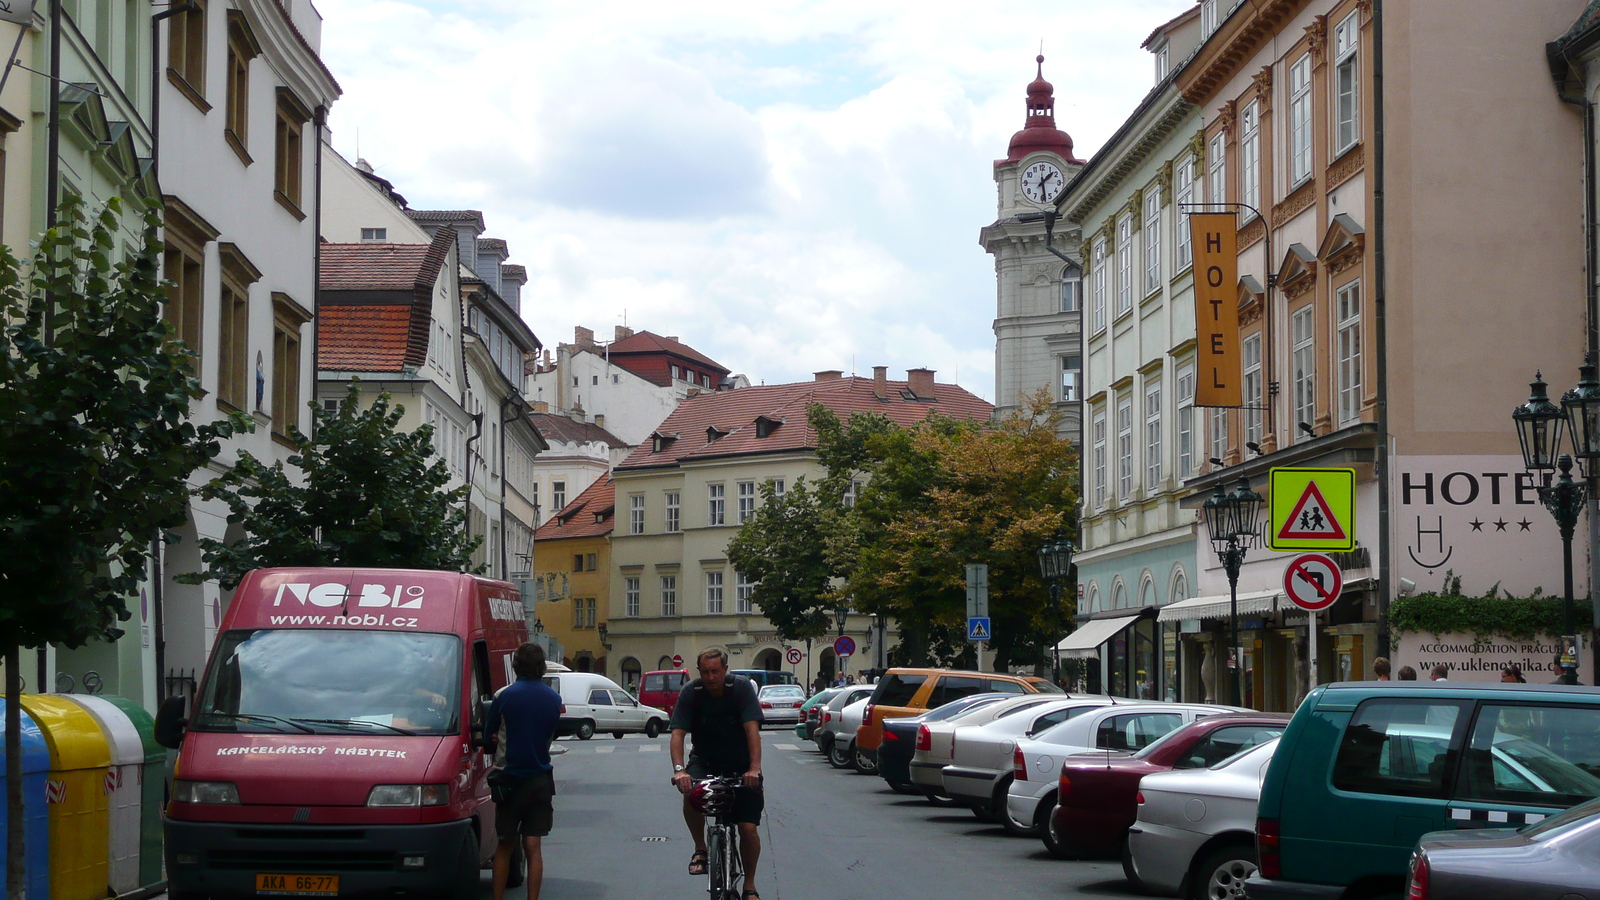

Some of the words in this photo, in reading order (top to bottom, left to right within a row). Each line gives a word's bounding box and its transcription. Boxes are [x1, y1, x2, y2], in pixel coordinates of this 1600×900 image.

[1206, 232, 1226, 389] HOTEL
[270, 613, 418, 628] www.nobl.cz
[1419, 643, 1518, 654] ACCOMMODATION
[216, 745, 327, 756] KANCELÁŘSKÝ
[334, 746, 407, 759] NÁBYTEK
[262, 875, 286, 890] AKA
[296, 876, 333, 891] 66-77
